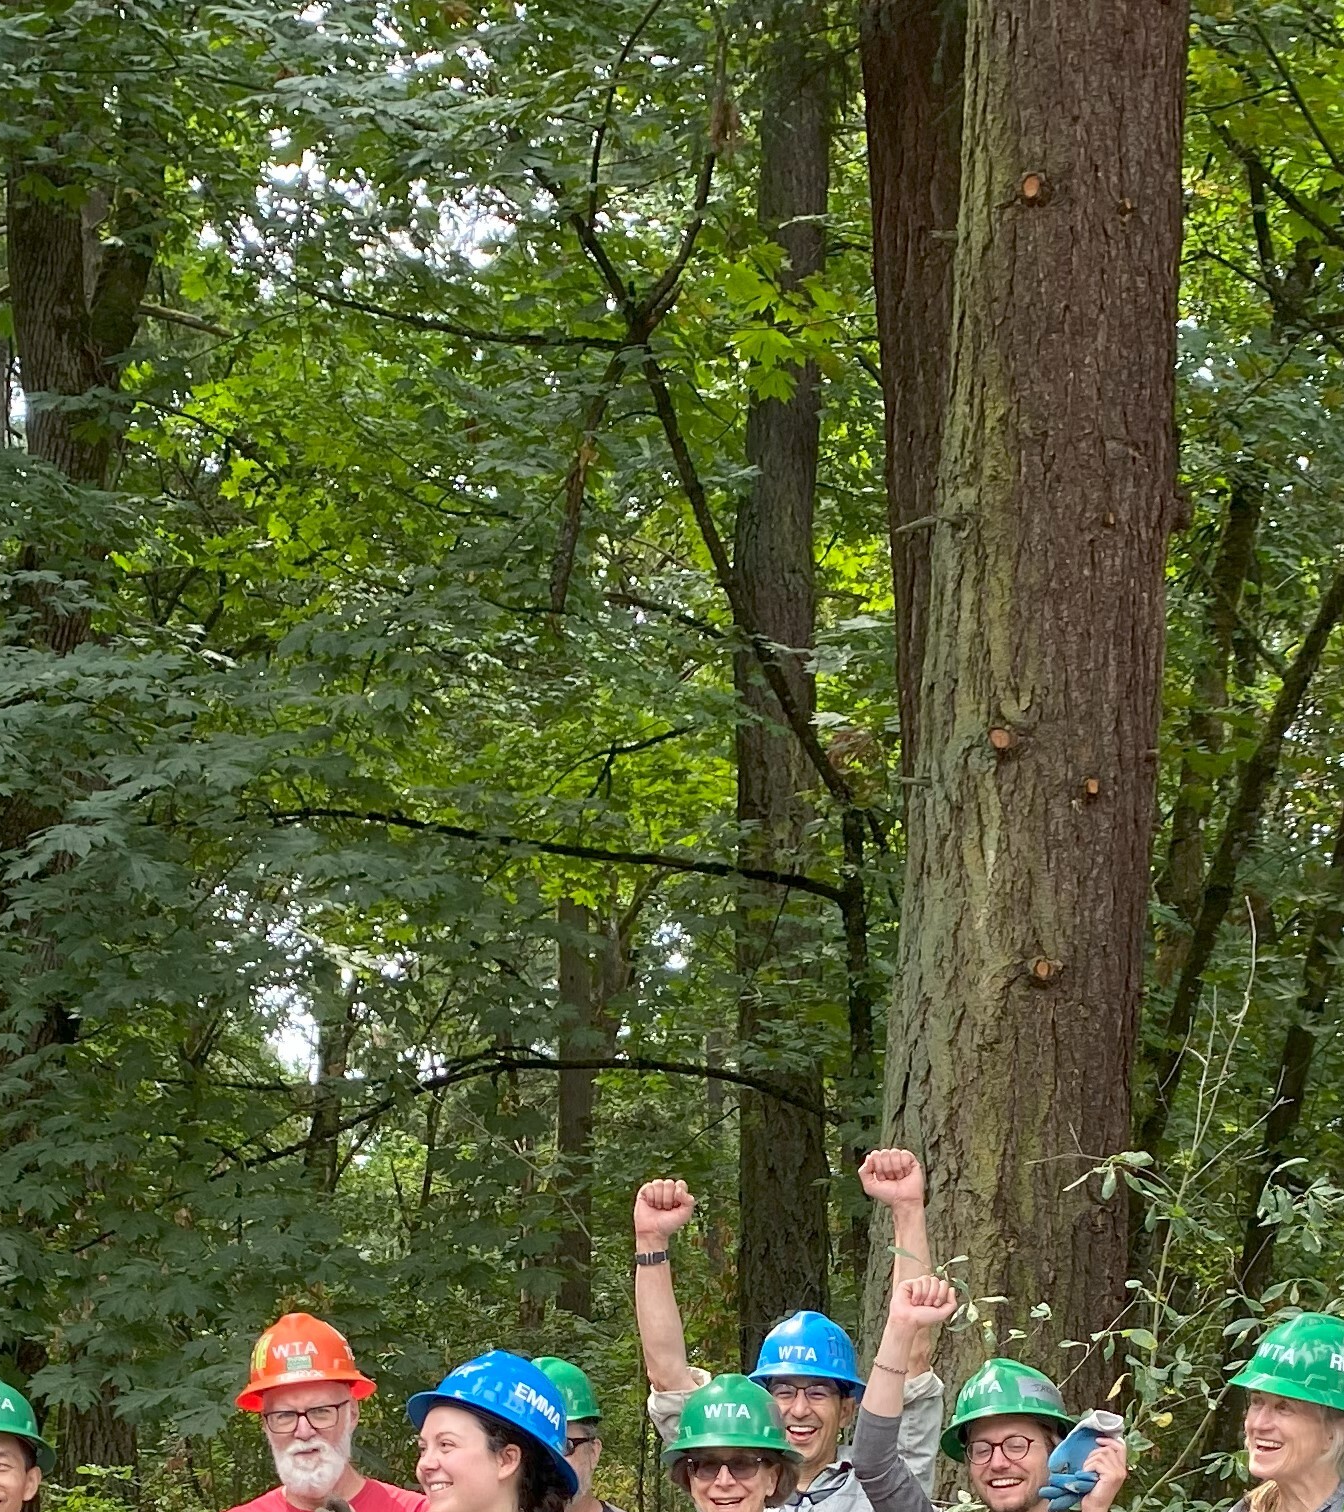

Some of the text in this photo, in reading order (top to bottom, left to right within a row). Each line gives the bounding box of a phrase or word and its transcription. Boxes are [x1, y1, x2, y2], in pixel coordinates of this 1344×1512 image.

[272, 1341, 319, 1359] WTA
[778, 1345, 818, 1362] WTA
[1258, 1342, 1295, 1368] WTA
[961, 1380, 1003, 1402] WTA
[514, 1381, 562, 1431] EMMA
[703, 1403, 752, 1419] WTA
